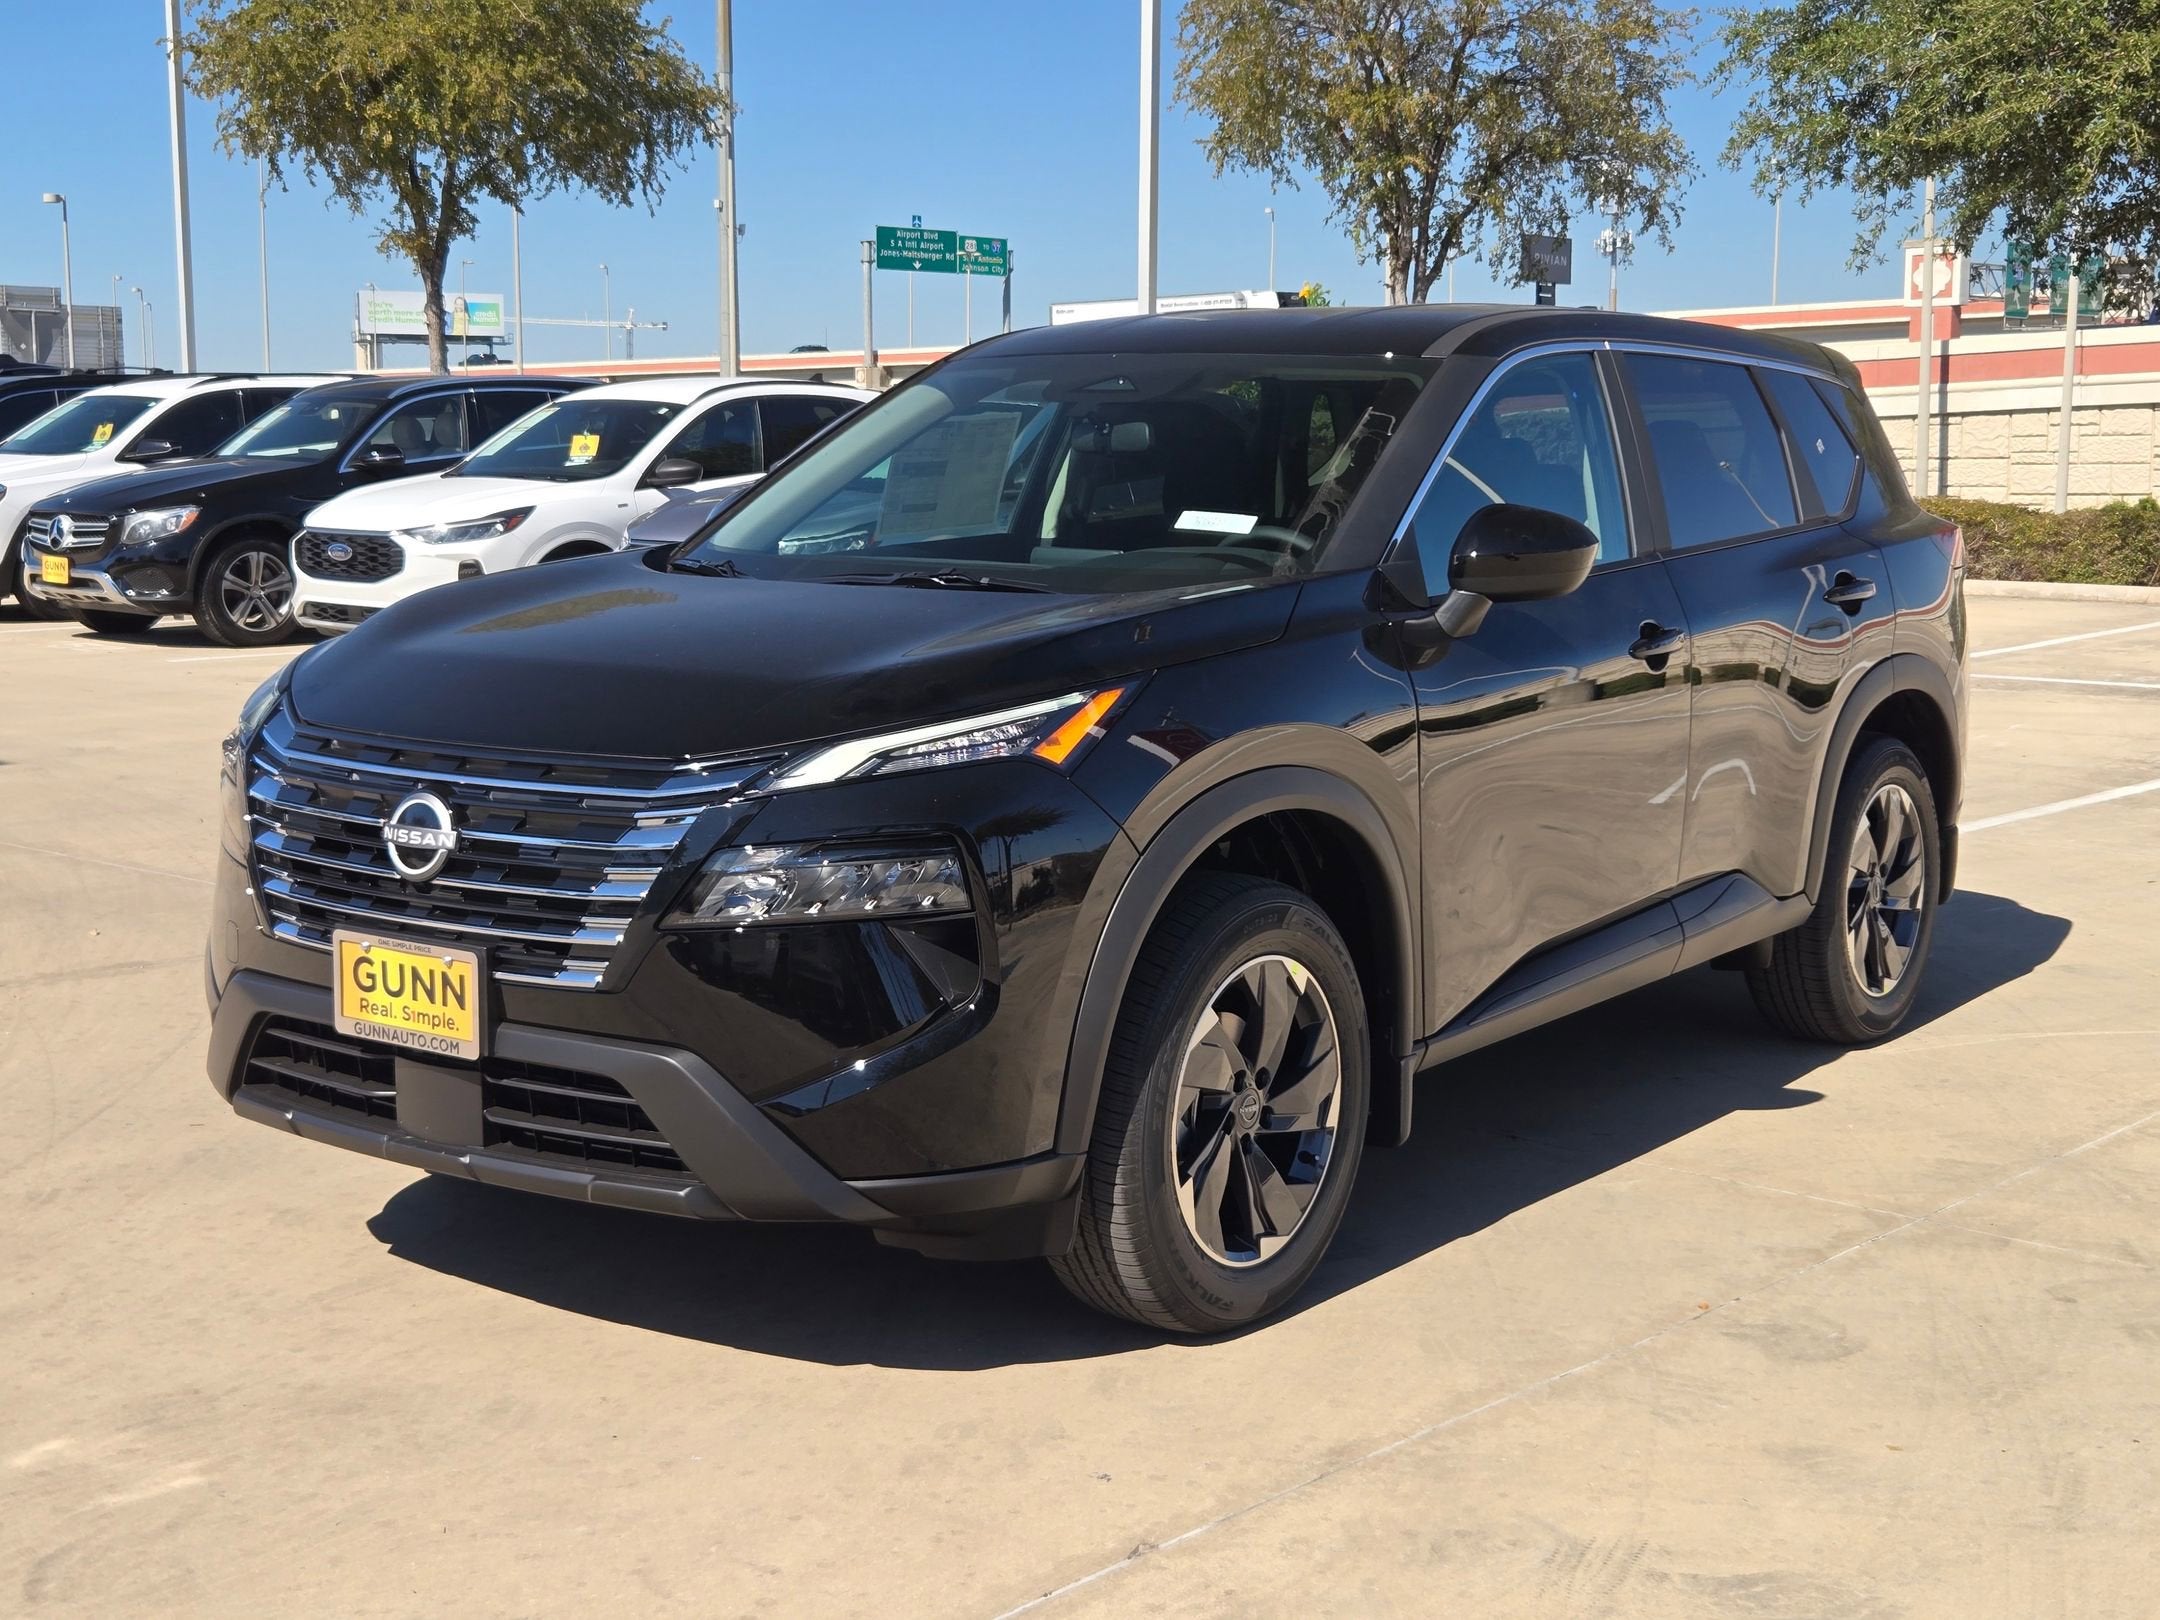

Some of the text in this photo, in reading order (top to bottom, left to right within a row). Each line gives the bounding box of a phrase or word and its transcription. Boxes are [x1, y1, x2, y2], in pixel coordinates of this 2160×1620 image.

[896, 230, 939, 240] Airport Blvd
[920, 241, 944, 251] Airport
[880, 249, 955, 261] Jones-Maltsberger Rd
[991, 264, 1005, 275] City
[45, 561, 66, 571] GUNN
[383, 825, 455, 848] NISSAN
[378, 938, 433, 954] ONE SIMPLE PRICE
[353, 955, 467, 1011] GUNN
[359, 997, 398, 1020] Real.
[354, 1021, 461, 1055] GUNNAUTO.COM
